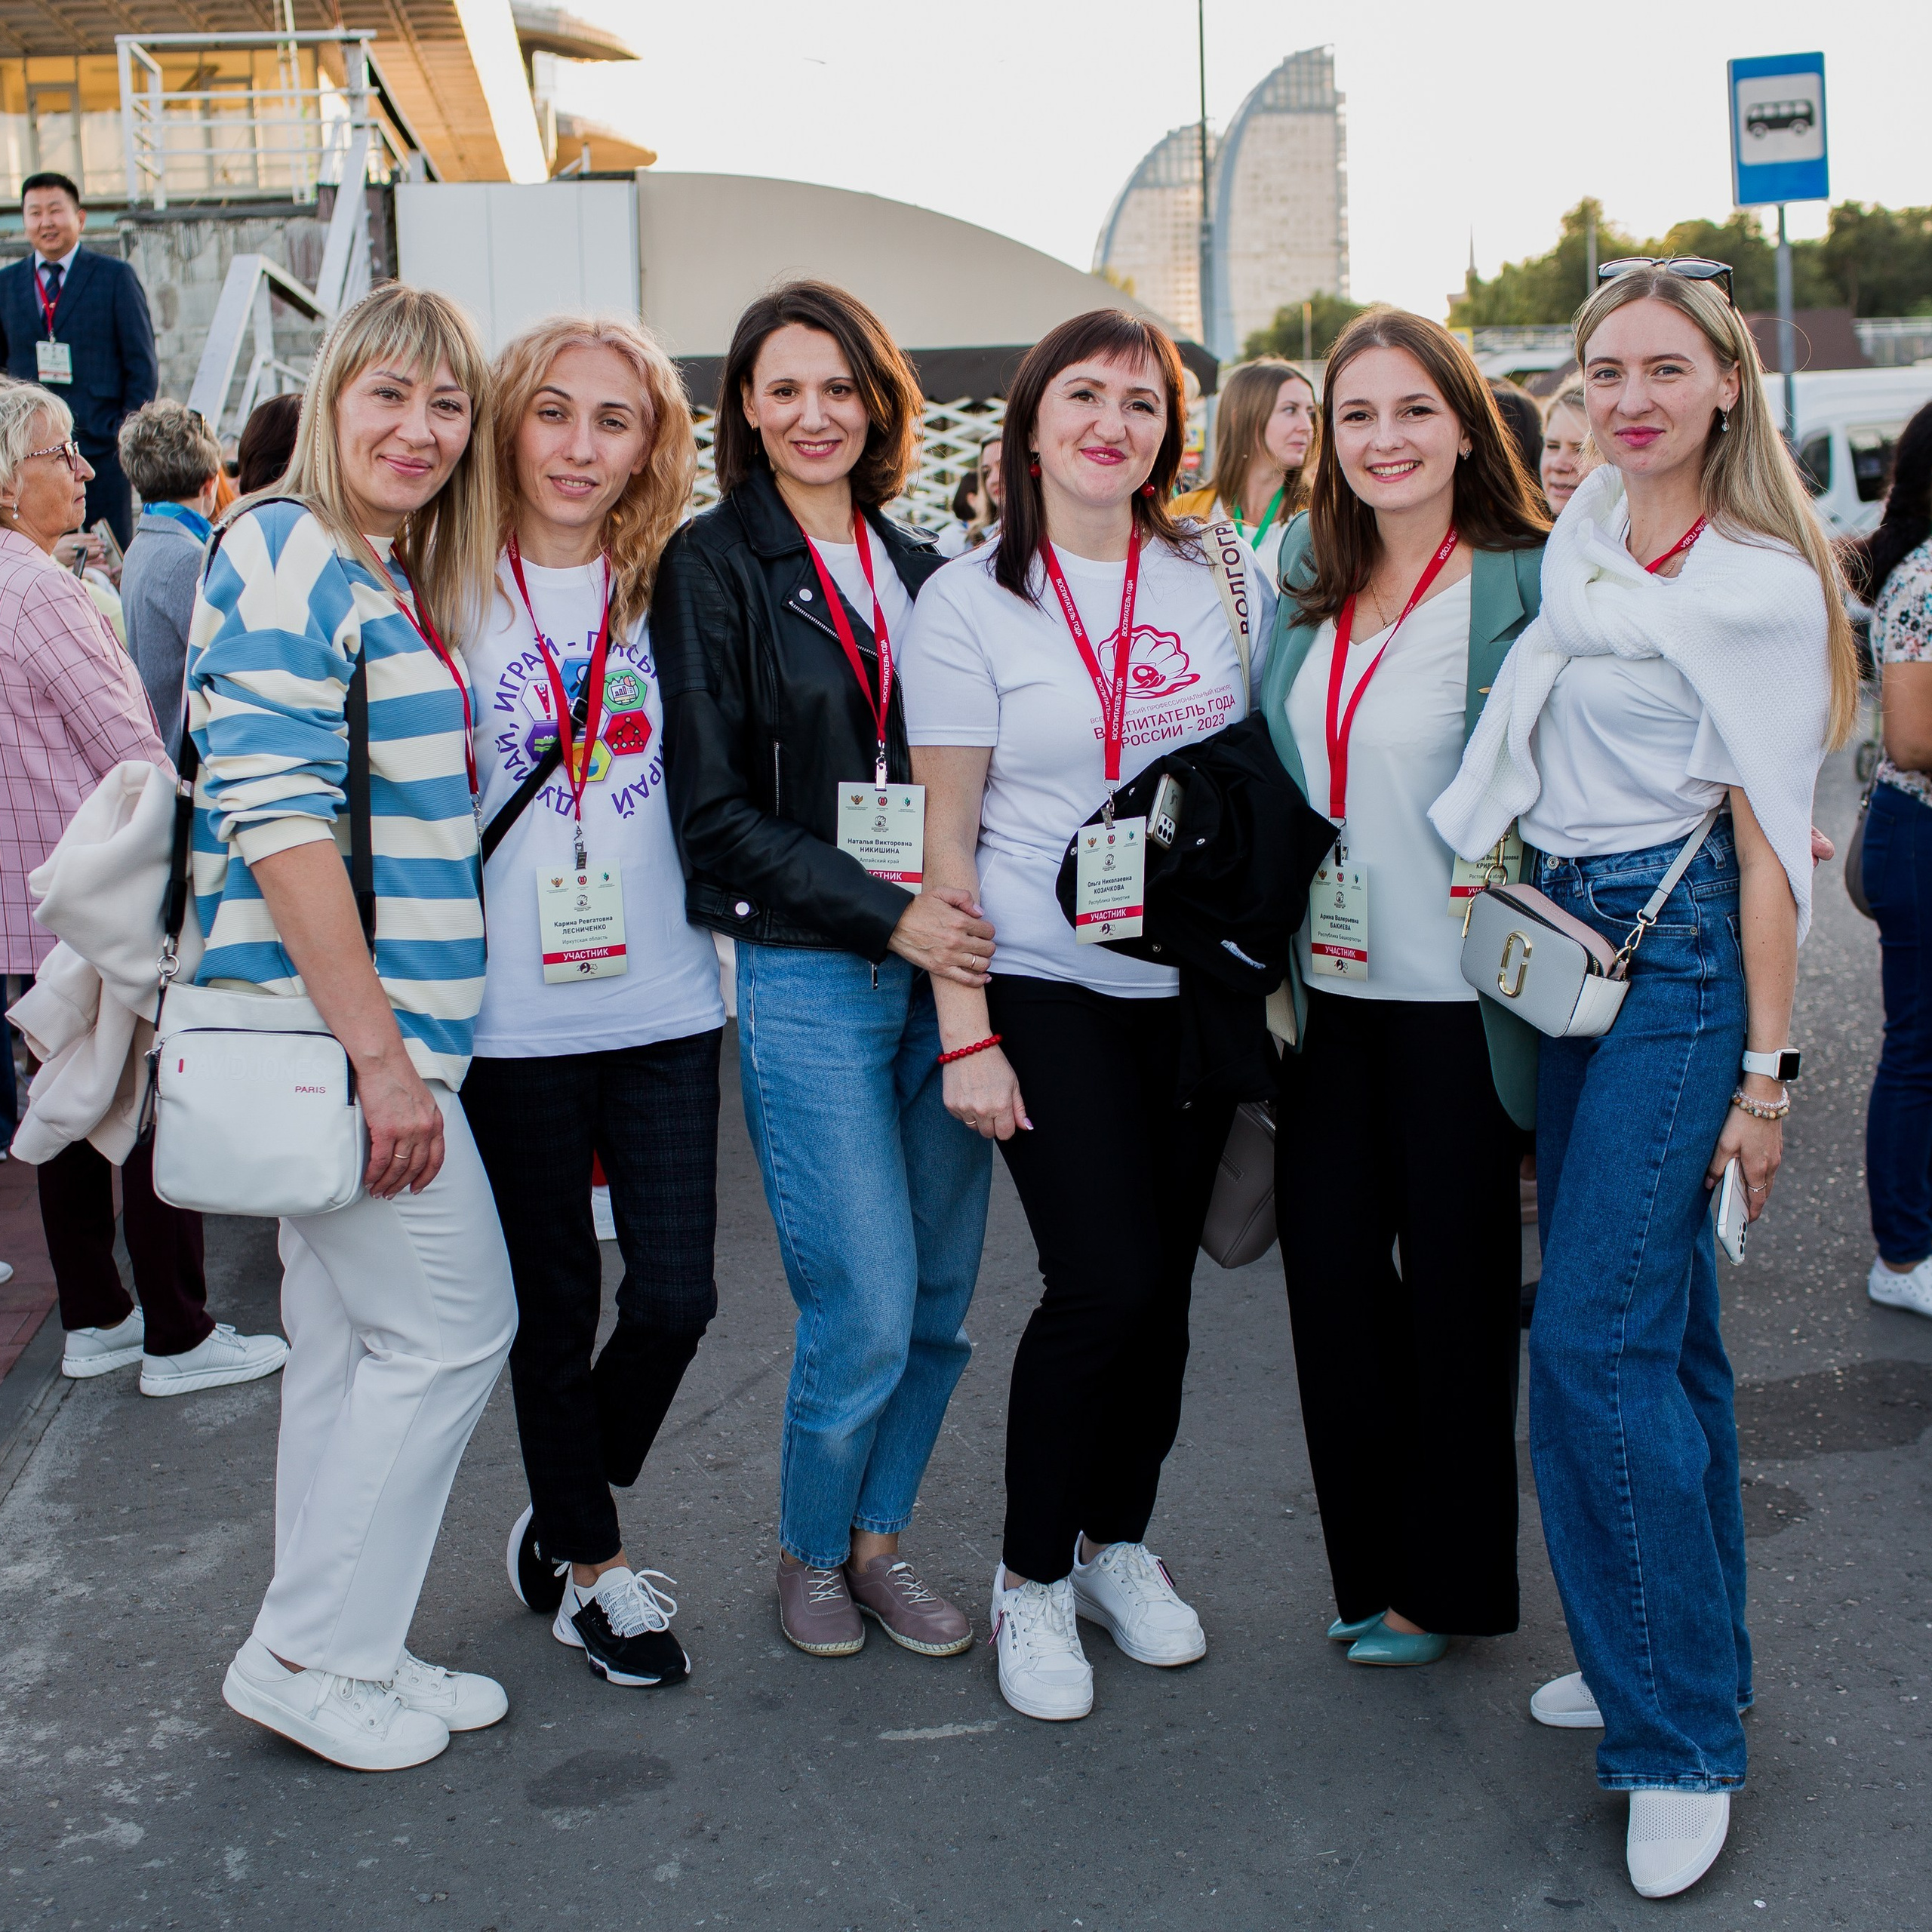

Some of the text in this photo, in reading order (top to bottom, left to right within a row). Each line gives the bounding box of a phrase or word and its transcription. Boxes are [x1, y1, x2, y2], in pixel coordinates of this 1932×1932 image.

[1214, 522, 1249, 635] ВОЛГОГР
[1056, 578, 1082, 637] ВОСПИТАТЕЛЬ ГОДА
[1121, 595, 1131, 637] ВОСПИТАТЕЛЬ
[881, 639, 889, 654] ГОДА
[1147, 688, 1214, 712] ПРОФЕССИОНАЛЬНЫЙ
[1214, 684, 1232, 694] КОНКУРС
[1208, 694, 1235, 712] ГОДА
[1112, 694, 1121, 740] ВОСПИТАТЕЛЬ
[1121, 724, 1183, 749] РОССИИ
[1197, 713, 1225, 731] 2023
[1102, 876, 1132, 884] Николаевна
[1094, 884, 1124, 894] КОЗАЧКОВА
[579, 915, 613, 924] Ревгатовна
[1091, 909, 1127, 921] УЧАСТНИК
[1335, 915, 1359, 924] Валерьевна
[562, 924, 606, 934] ЛЕСНИЧЕНКО
[1330, 922, 1351, 931] БАКИЕВА
[563, 948, 609, 961] УЧАСТНИК
[1325, 946, 1356, 958] УЧАСТНИК
